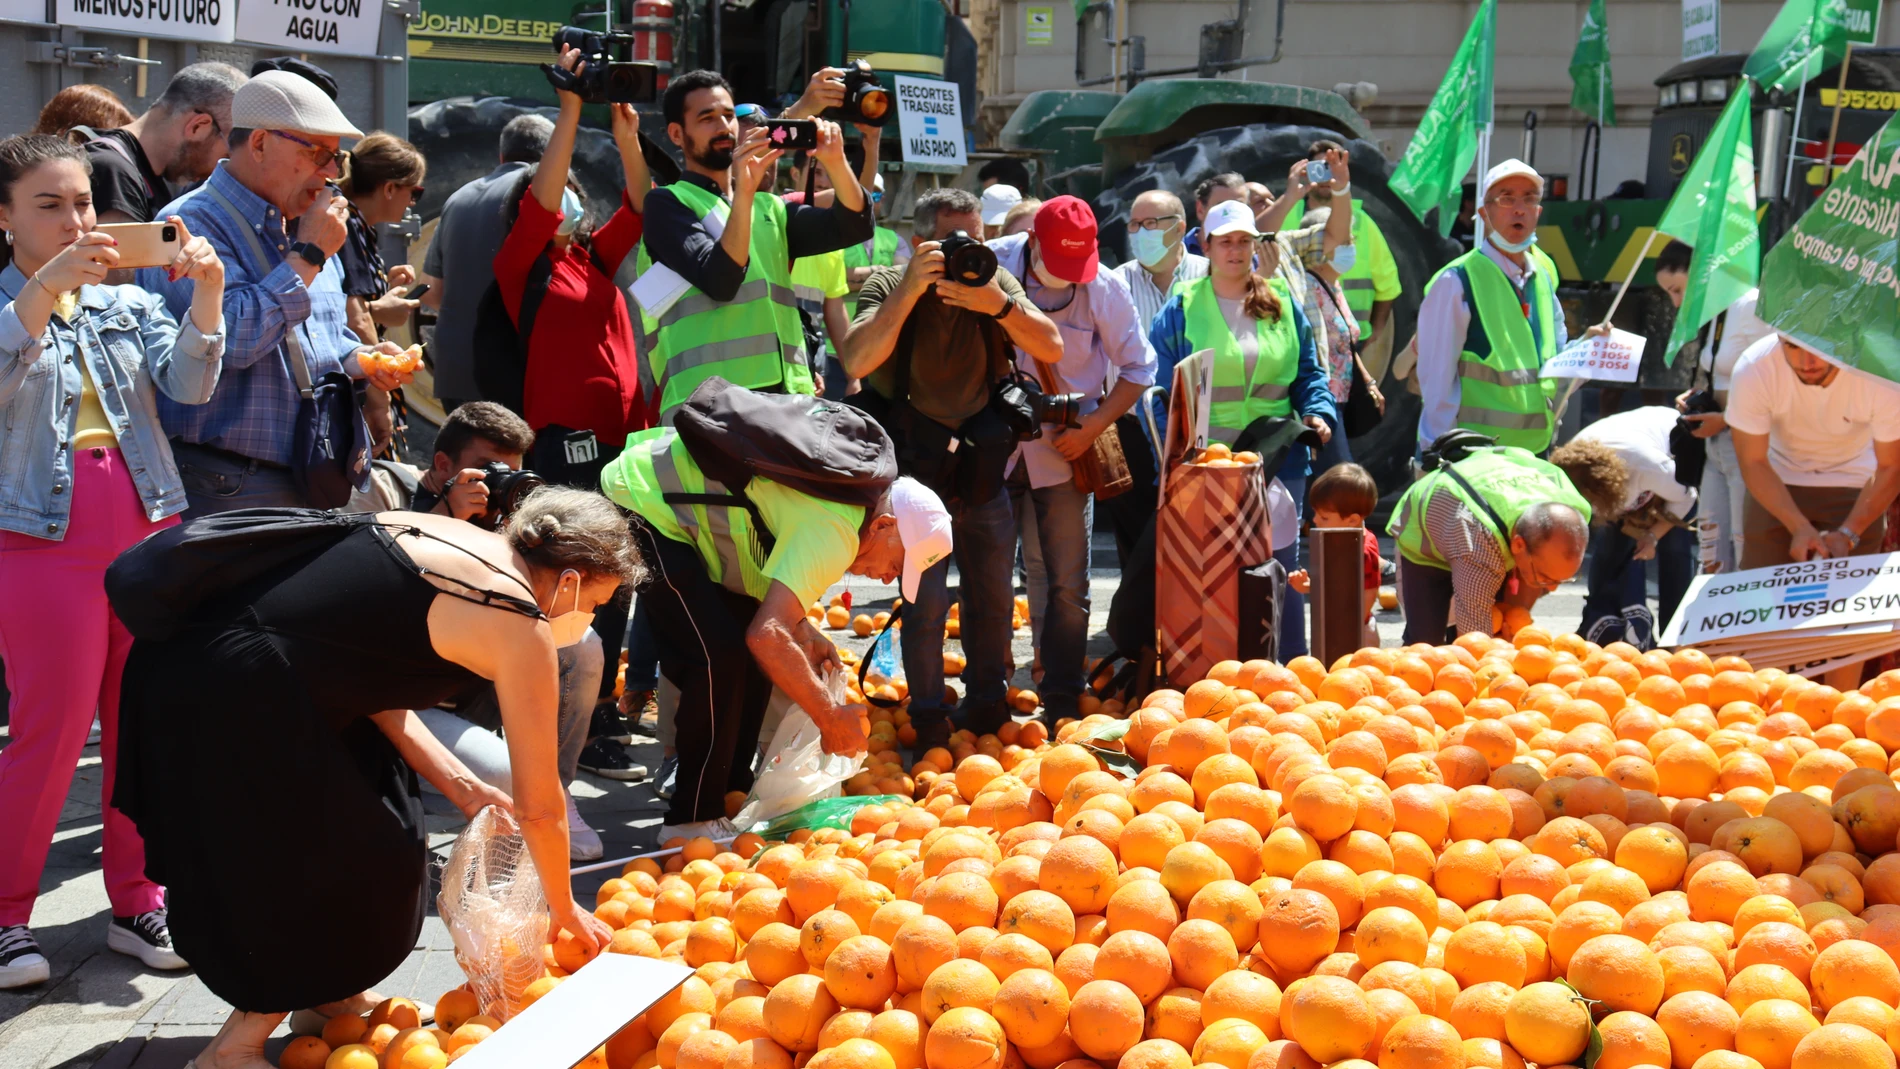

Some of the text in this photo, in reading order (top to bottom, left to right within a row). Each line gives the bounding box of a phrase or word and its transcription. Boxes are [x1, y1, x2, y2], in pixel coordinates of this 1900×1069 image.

[148, 0, 220, 26] FUTURO
[286, 14, 339, 45] AGUA
[412, 11, 564, 38] JOHN DEERE
[900, 84, 955, 102] RECORTES
[902, 99, 956, 116] TRASVASE
[910, 132, 957, 158] MÁS PARO
[1553, 360, 1586, 368] AGUA
[1598, 361, 1629, 370] PSOE
[1601, 351, 1631, 360] PSOE
[1773, 560, 1849, 577] DE CO2
[1708, 572, 1830, 598] SUMIDEROS
[1853, 593, 1900, 615] MÁS
[1700, 599, 1847, 633] DESALACIÓN
